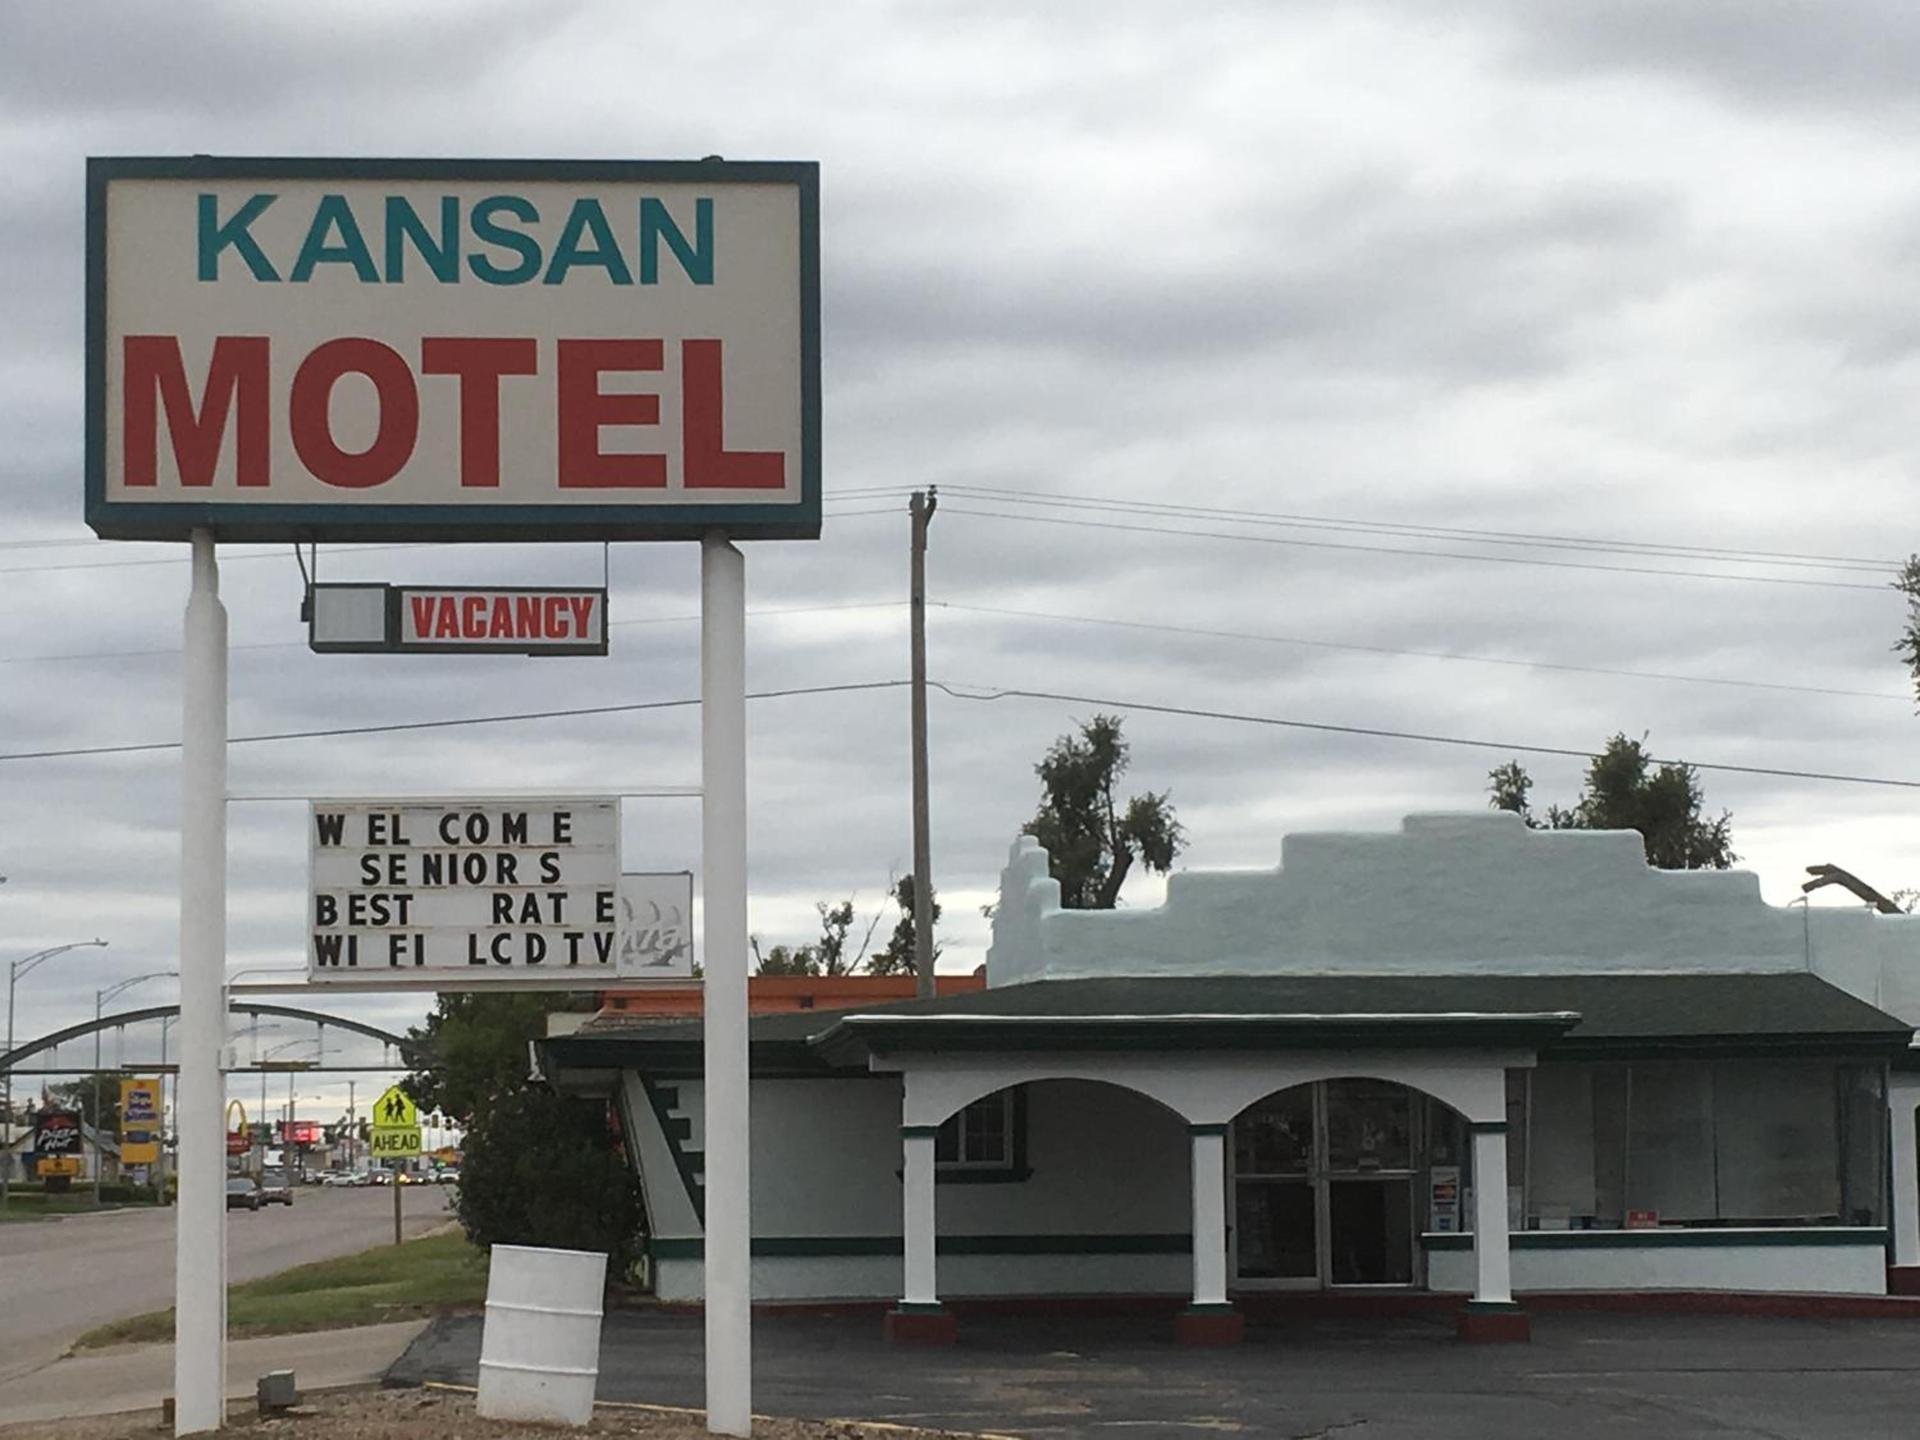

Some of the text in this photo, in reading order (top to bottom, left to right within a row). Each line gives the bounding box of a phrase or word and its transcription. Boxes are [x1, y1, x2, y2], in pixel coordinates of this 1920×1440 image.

[198, 194, 713, 285] KANSAN
[123, 335, 785, 489] MOTEL
[411, 596, 594, 638] VACANCY
[360, 851, 561, 886] SENIORS
[315, 890, 615, 927] BEST RATE
[373, 1134, 419, 1150] AHEAD
